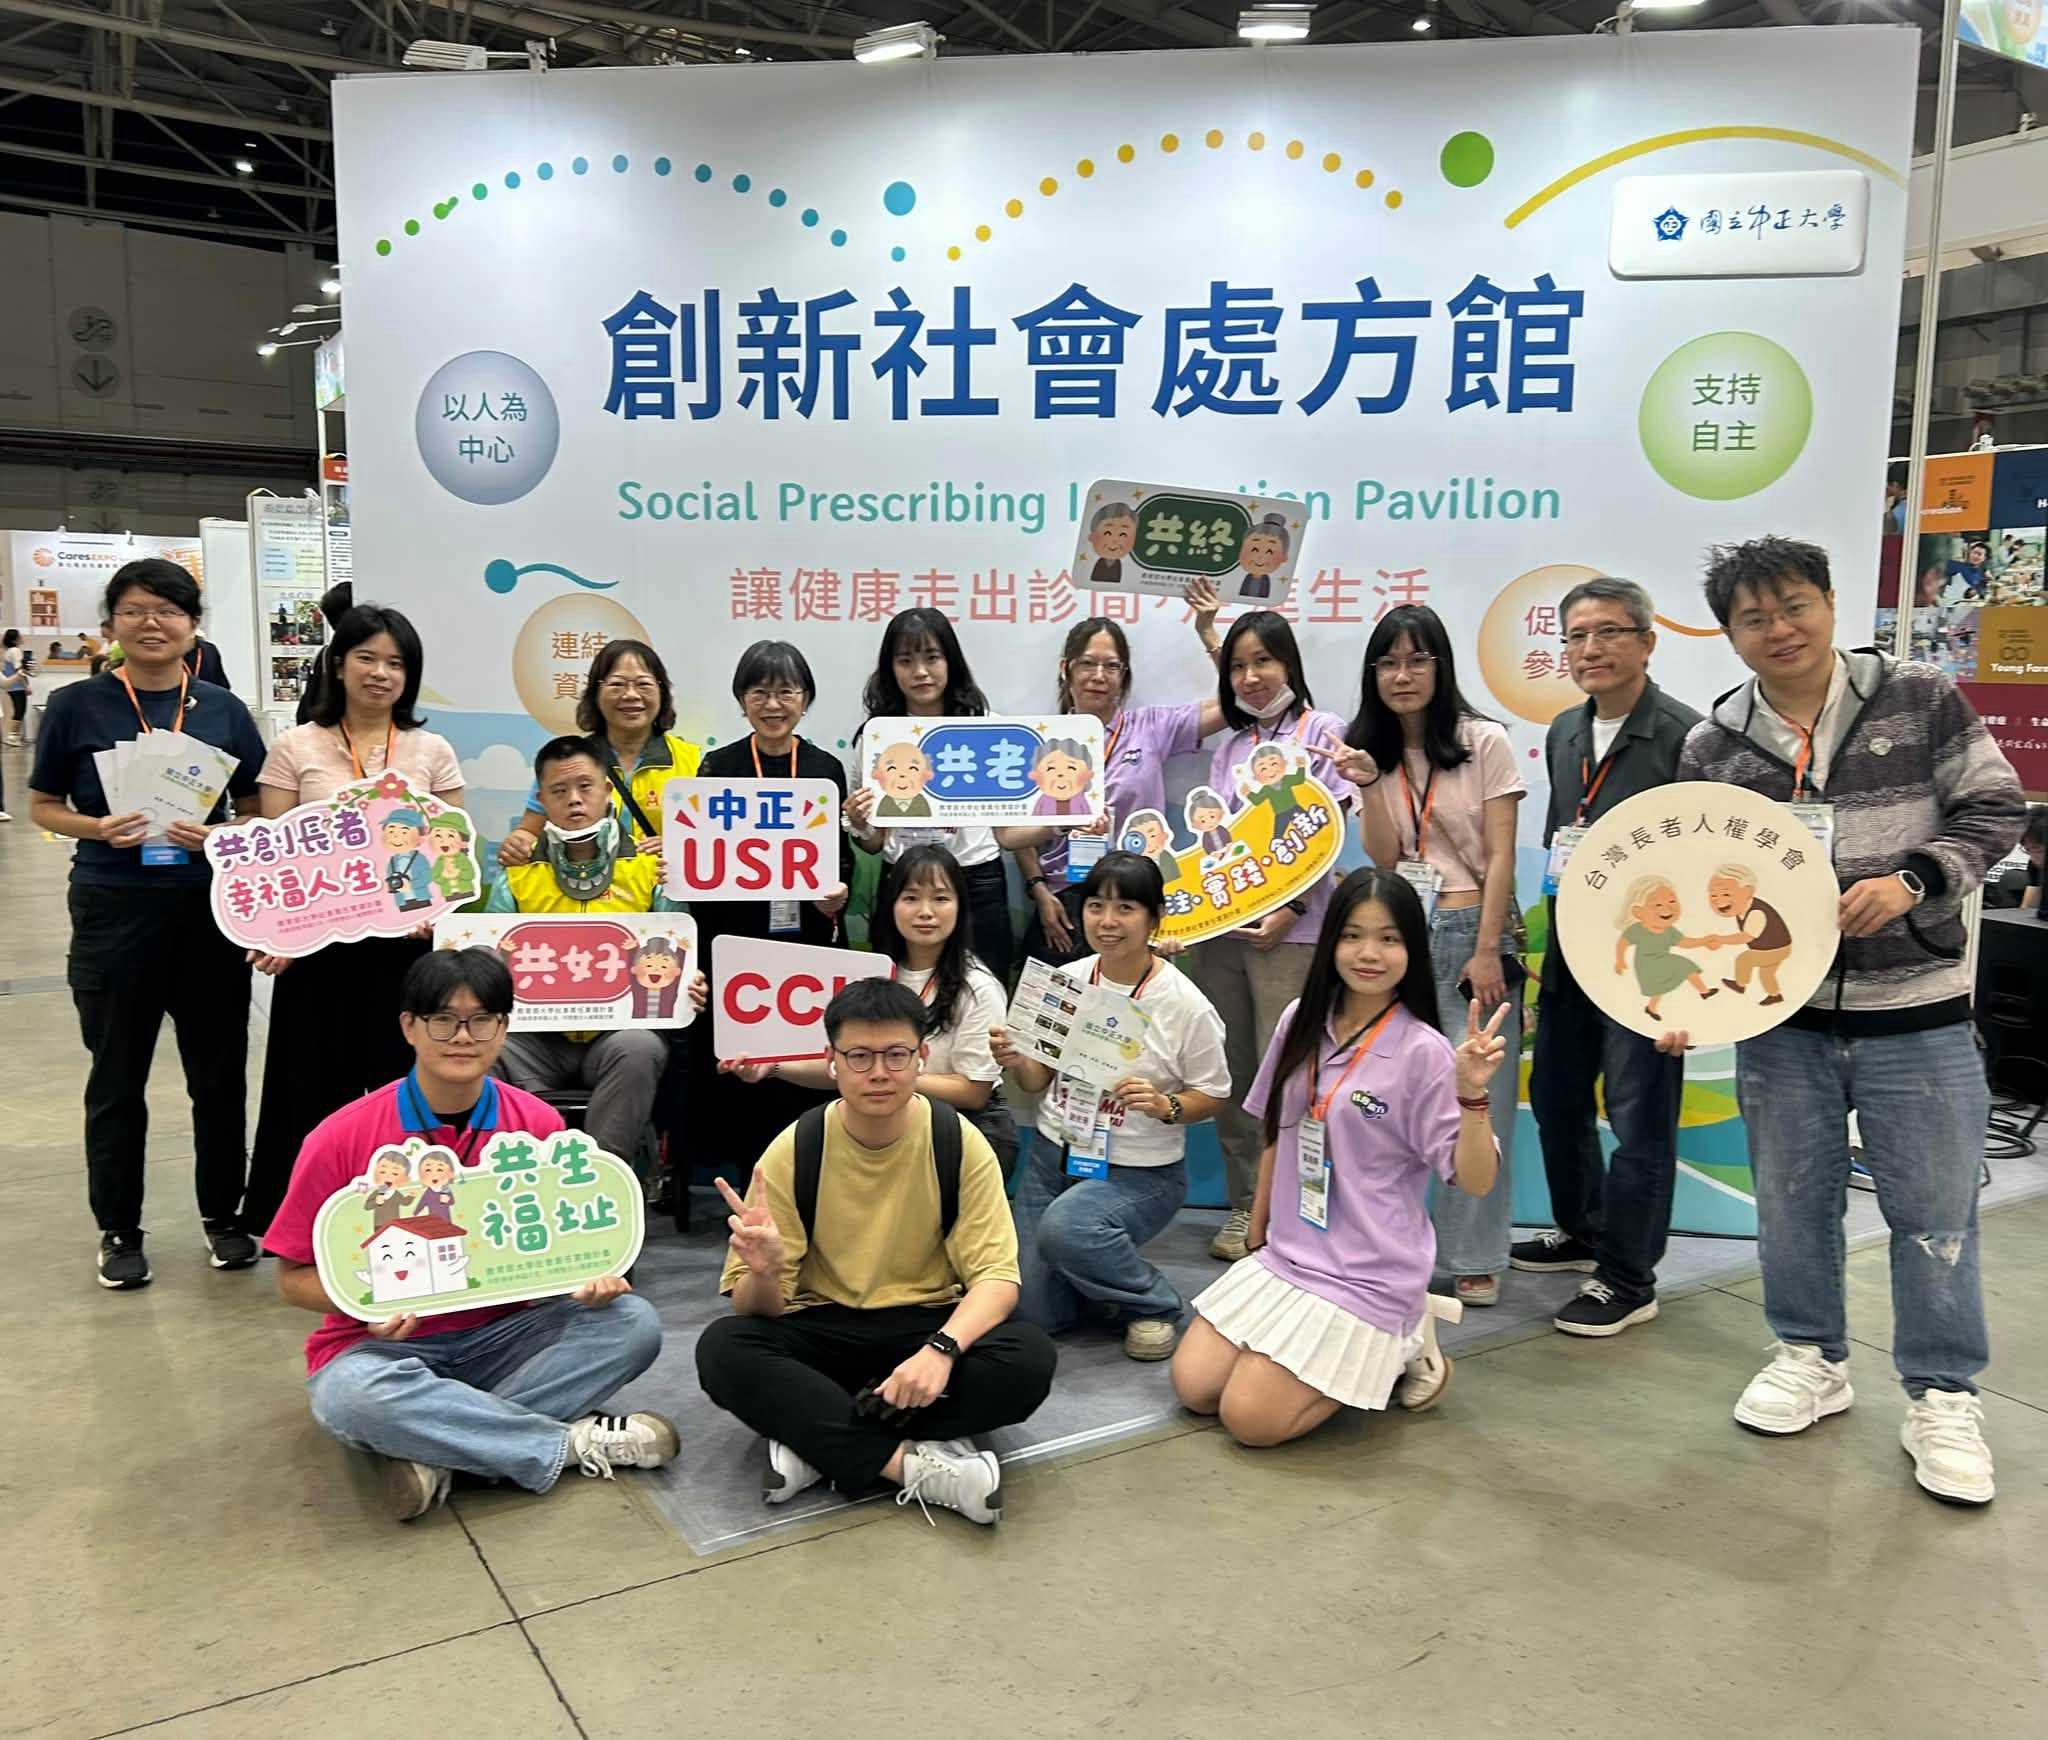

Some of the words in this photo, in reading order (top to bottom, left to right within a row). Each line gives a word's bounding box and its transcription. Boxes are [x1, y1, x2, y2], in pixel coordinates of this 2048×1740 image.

[602, 274, 1587, 421] 創新社會處方館
[442, 392, 529, 423] 以人為
[1691, 373, 1761, 406] 支持
[457, 435, 516, 465] 中心
[1692, 420, 1757, 451] 自主
[617, 481, 757, 521] Social
[779, 480, 1045, 534] Prescribing
[1356, 478, 1561, 520] Pavilion
[1144, 511, 1235, 563] 共終
[1525, 605, 1565, 636] 促
[552, 672, 592, 701] 資
[936, 737, 1027, 790] 共老
[708, 788, 795, 831] 中正
[213, 808, 367, 869] 共創長者
[684, 838, 820, 891] USR
[1584, 812, 1806, 890] 台灣長者人權學會
[227, 858, 379, 918] 幸福人生
[512, 941, 627, 990] 共好
[723, 972, 847, 1026] CC
[490, 1138, 597, 1192] 共生
[482, 1193, 618, 1253] 福址
